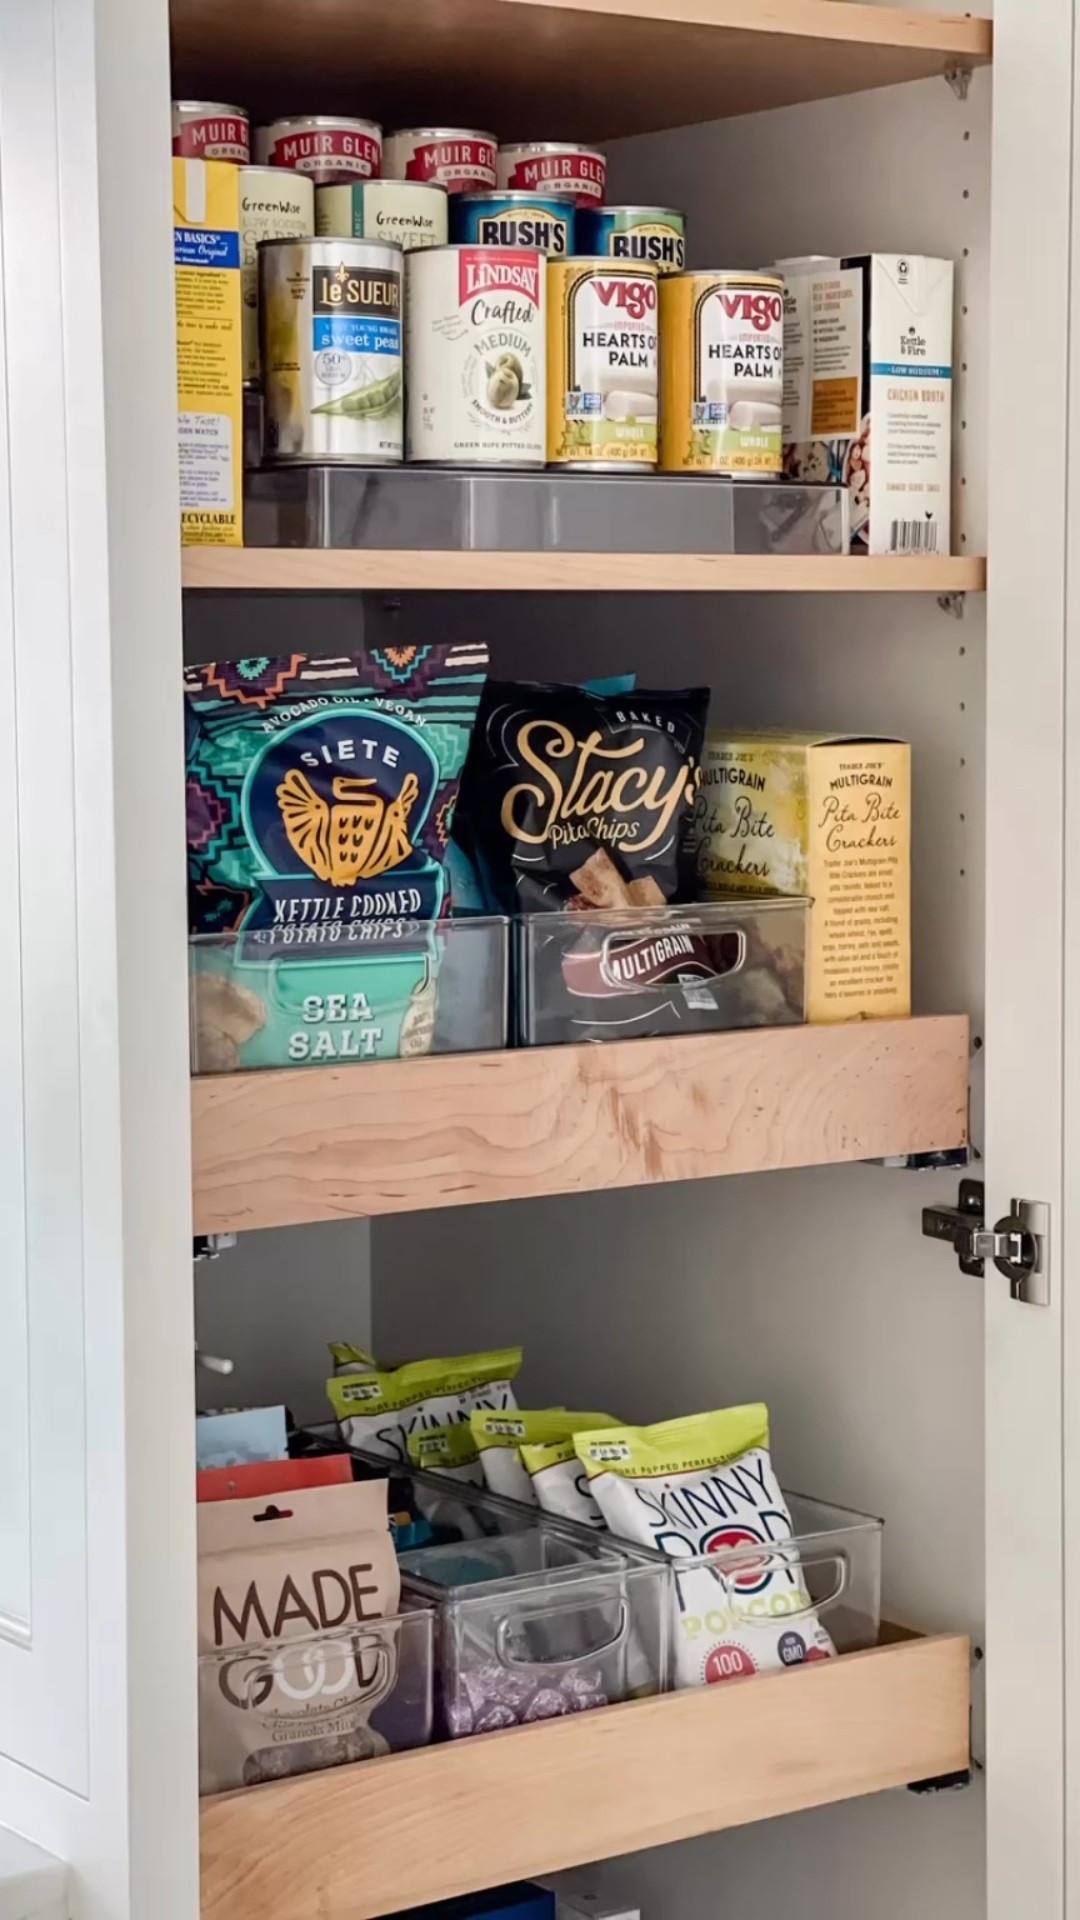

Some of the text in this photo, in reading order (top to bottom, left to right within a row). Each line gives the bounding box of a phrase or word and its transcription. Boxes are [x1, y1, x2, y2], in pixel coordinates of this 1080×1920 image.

[191, 122, 236, 146] MUIR
[283, 135, 380, 165] MUIR GLEN
[424, 145, 471, 168] MUIR
[302, 158, 368, 171] ORGANIC
[524, 160, 572, 183] MUIR
[242, 197, 301, 214] GreenWise
[376, 211, 434, 228] GreenWise
[482, 221, 565, 253] BUSH'S
[198, 244, 228, 260] Original
[613, 236, 684, 268] BUSH'S
[319, 277, 343, 306] Le
[346, 279, 399, 307] SUEUR
[471, 298, 534, 326] Crafted
[321, 332, 399, 351] sweet peas
[473, 332, 532, 357] MEDIUM
[582, 332, 646, 349] HEARTS
[708, 344, 771, 360] HEARTS
[900, 336, 926, 347] Kettle
[900, 346, 927, 356] & Fire
[608, 350, 649, 368] PALM
[734, 362, 774, 378] PALM
[908, 367, 940, 376] SODIUM
[887, 388, 919, 402] CHICKEN
[472, 399, 534, 425] SMOOTH & BUTTERY
[454, 441, 481, 449] GREEN
[740, 435, 770, 448] WHOLE
[261, 697, 328, 735] AVOCADO
[374, 697, 428, 728] VEGAN
[615, 711, 676, 733] BAKED
[300, 739, 400, 768] SIETE
[839, 762, 863, 771] TRADER
[501, 719, 704, 852] Stacy's
[829, 773, 893, 790] MULTIGRAIN
[695, 795, 775, 838] Pita Bite
[818, 792, 901, 828] Pita Bite
[550, 817, 640, 849] Pita Chips
[826, 823, 897, 852] Crackers
[697, 836, 771, 877] Crackers
[273, 888, 422, 923] KETTLE COOKED
[610, 934, 695, 981] MULTIGRAIN
[302, 992, 374, 1024] SEA
[288, 1028, 382, 1061] SALT
[641, 1461, 679, 1474] POPPED
[634, 1458, 774, 1530] SKINNY
[213, 1563, 382, 1646] MADE
[713, 1651, 743, 1676] 100
[782, 1646, 803, 1662] GMO
[218, 1633, 385, 1710] GOOD
[271, 1723, 324, 1742] Granola
